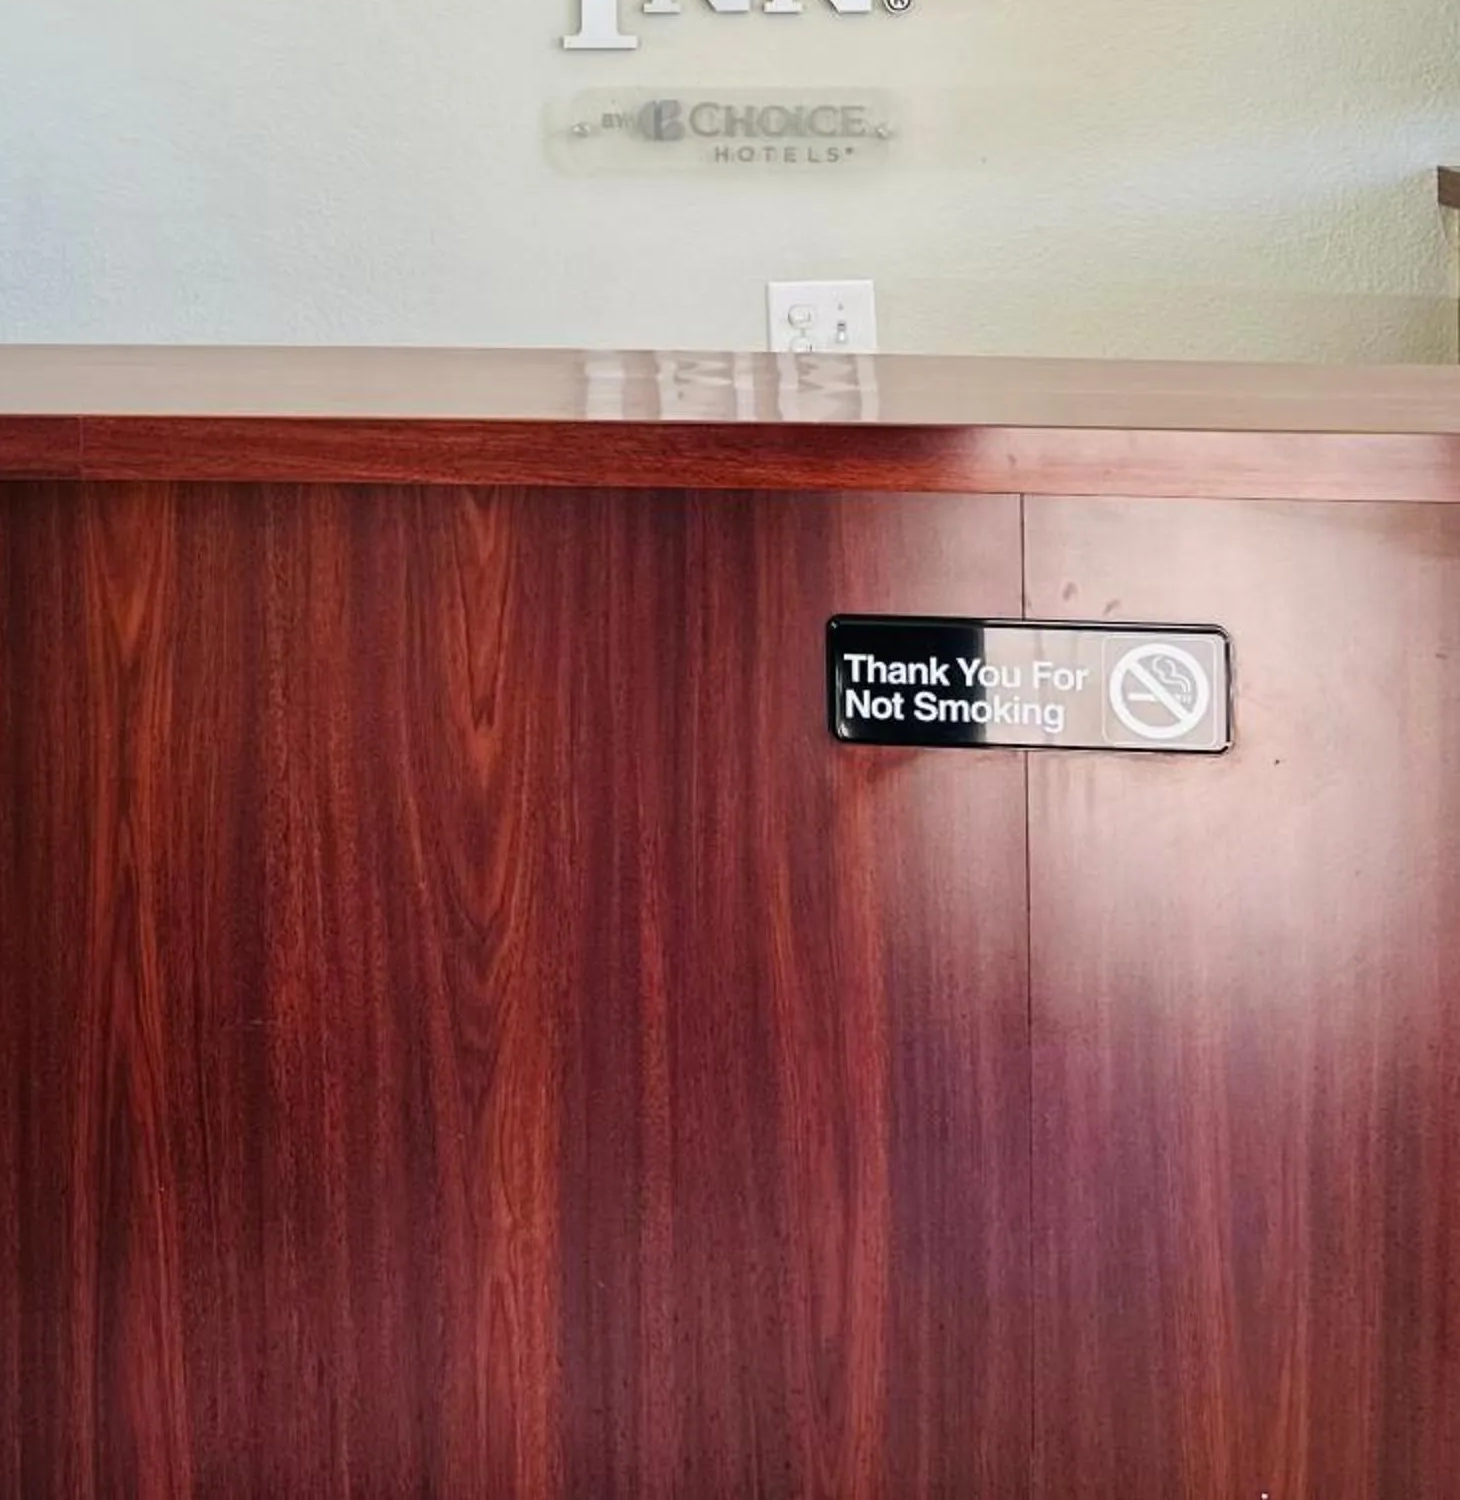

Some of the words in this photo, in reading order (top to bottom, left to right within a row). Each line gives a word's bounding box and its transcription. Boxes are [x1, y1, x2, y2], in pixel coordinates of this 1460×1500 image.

[688, 102, 867, 138] CHOICE
[843, 652, 951, 687] Thank
[956, 657, 1022, 688] You
[1032, 661, 1089, 691] For
[844, 689, 904, 720] Not
[913, 691, 1066, 734] Smoking
